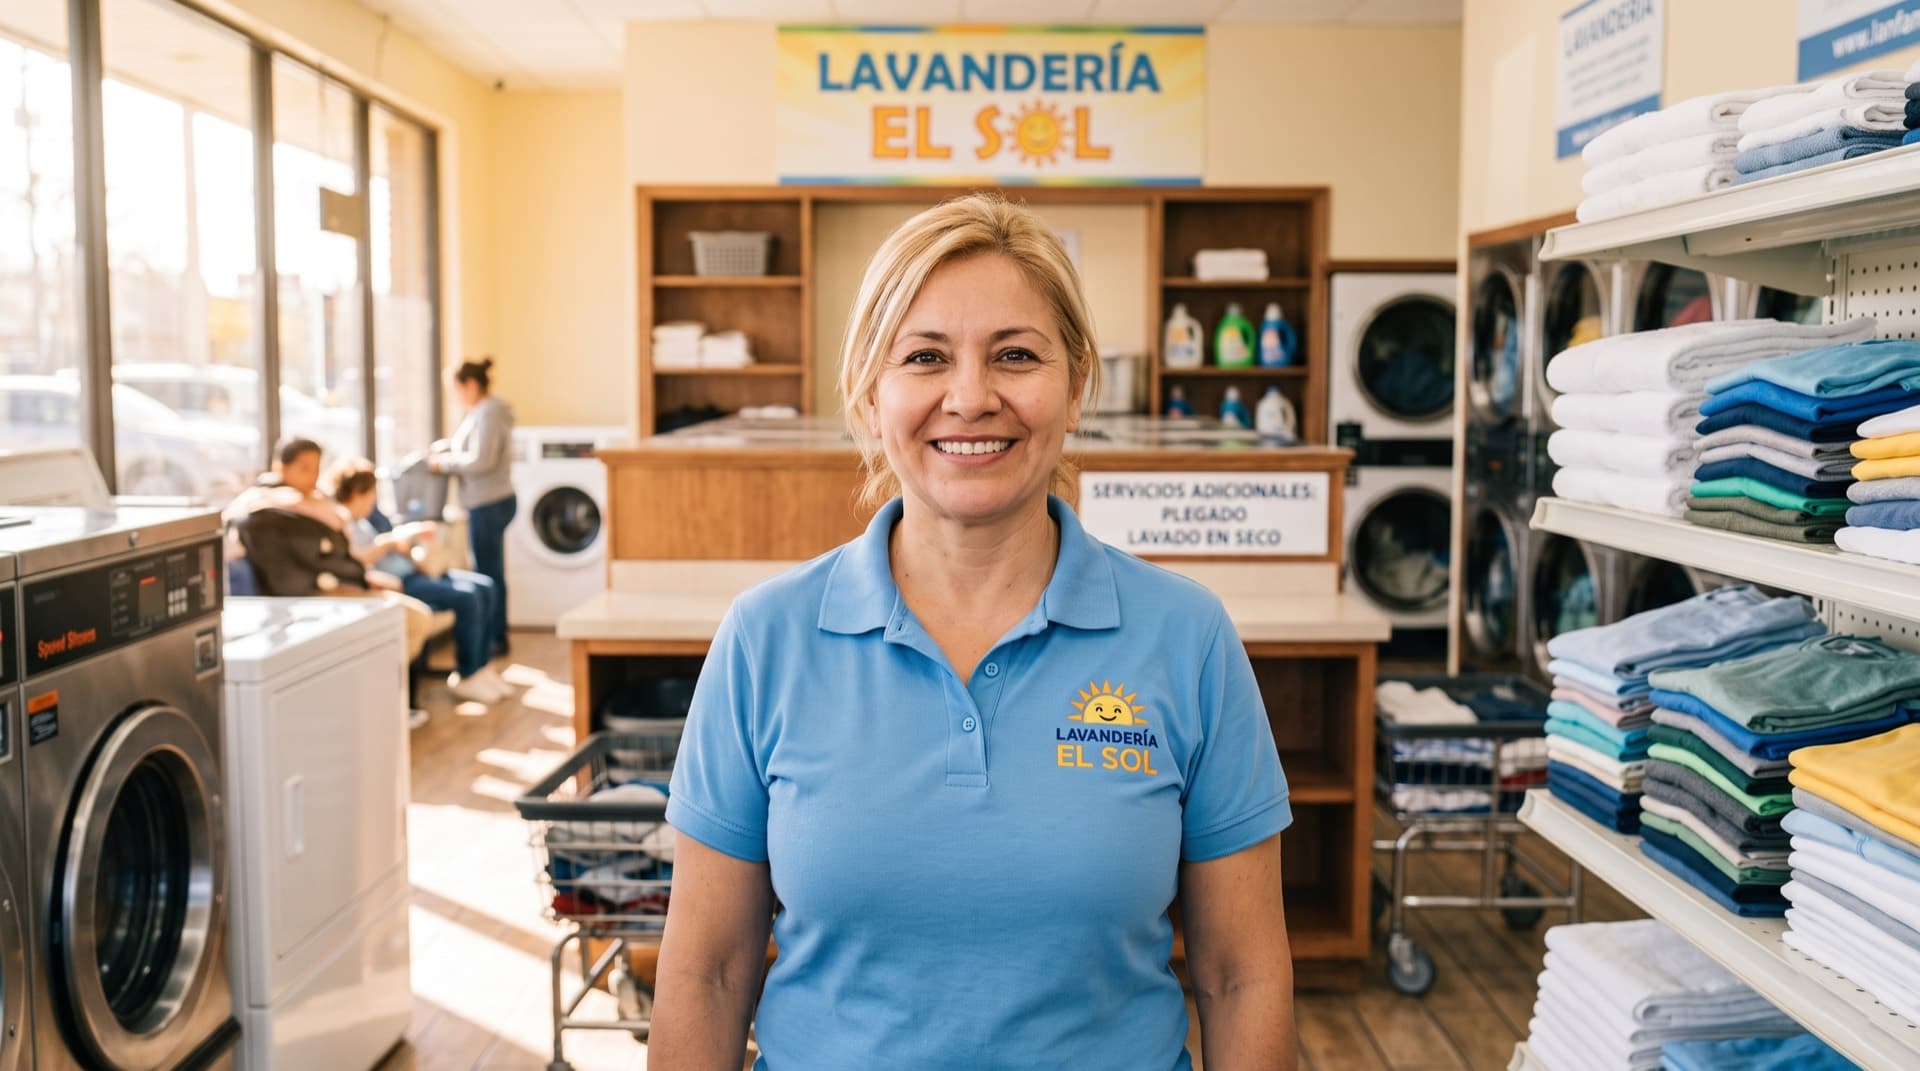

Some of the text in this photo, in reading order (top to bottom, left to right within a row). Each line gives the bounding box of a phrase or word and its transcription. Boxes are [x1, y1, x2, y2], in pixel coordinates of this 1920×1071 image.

[818, 42, 1161, 93] LAVANDERÍA
[870, 104, 952, 160] EL
[1093, 481, 1185, 499] SERVICIOS
[1161, 506, 1247, 522] PLEGADO
[1127, 529, 1282, 545] LAVADO EN SECO
[1056, 727, 1159, 749] LAVANDERÍA
[1056, 743, 1159, 777] EL SOL
